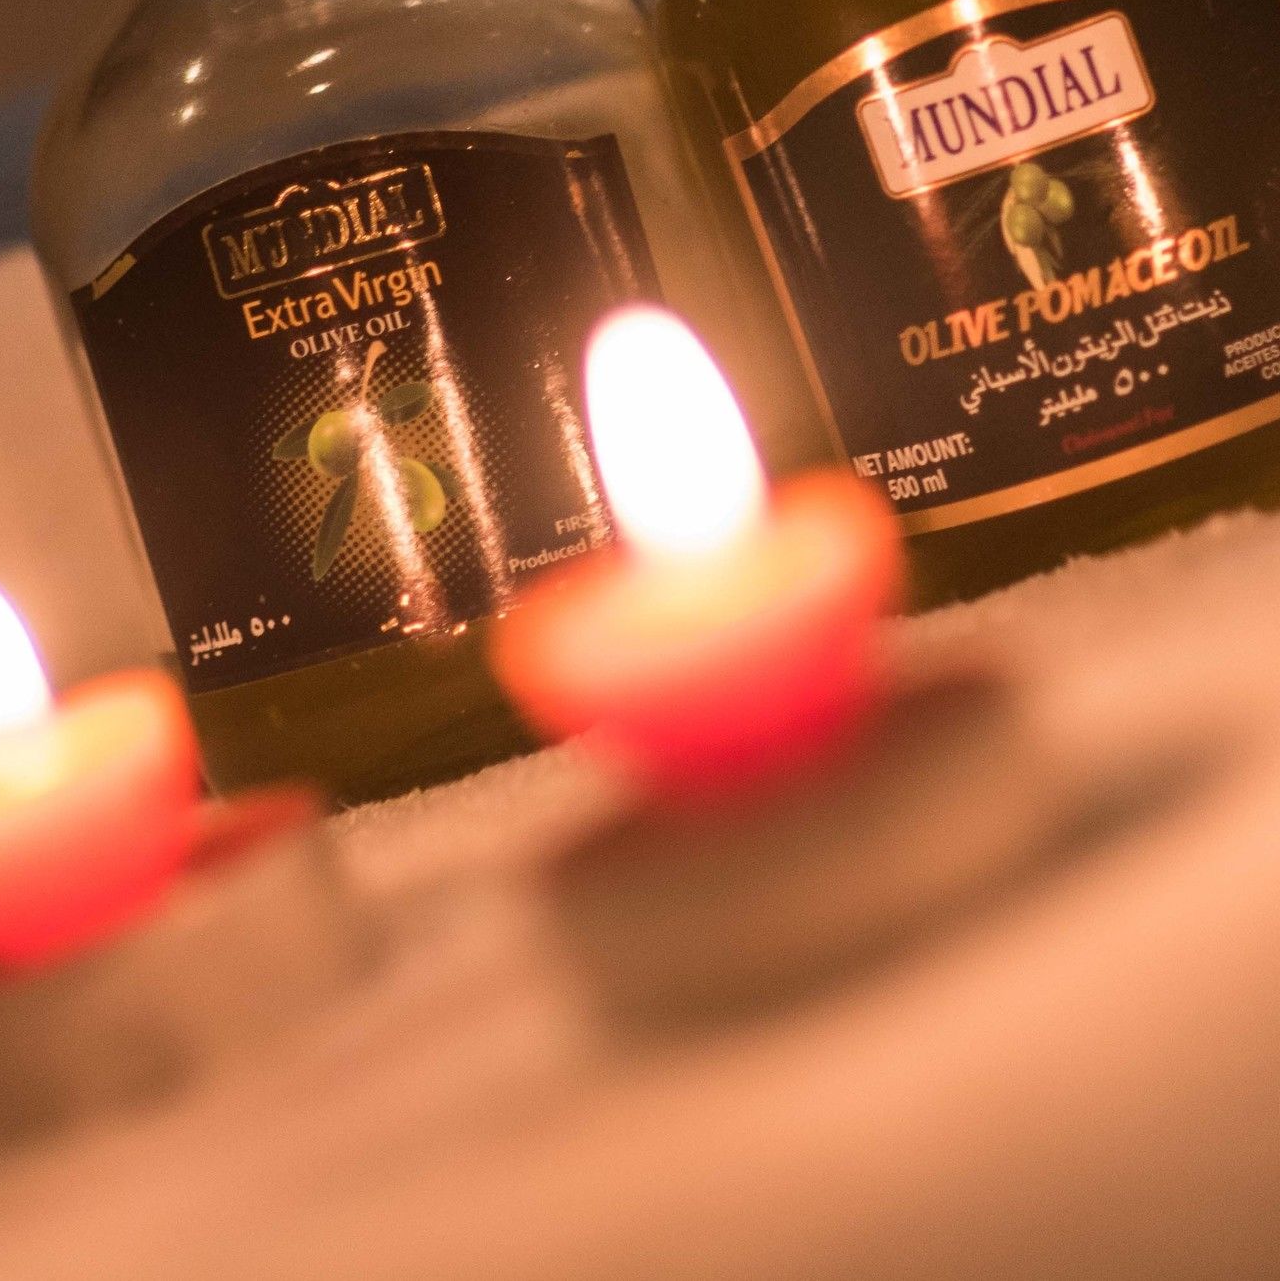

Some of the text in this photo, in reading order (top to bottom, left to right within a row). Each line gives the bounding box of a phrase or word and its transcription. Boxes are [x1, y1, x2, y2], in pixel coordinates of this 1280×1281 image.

[884, 45, 1122, 170] MUNDIAL
[242, 257, 443, 339] Extra Virgin
[898, 215, 1250, 367] OLIVE POMACE OIL
[290, 311, 411, 359] OLIVE OIL
[853, 432, 974, 478] NET AMOUNT:
[887, 468, 948, 500] 500 ml
[508, 538, 587, 573] Produced
